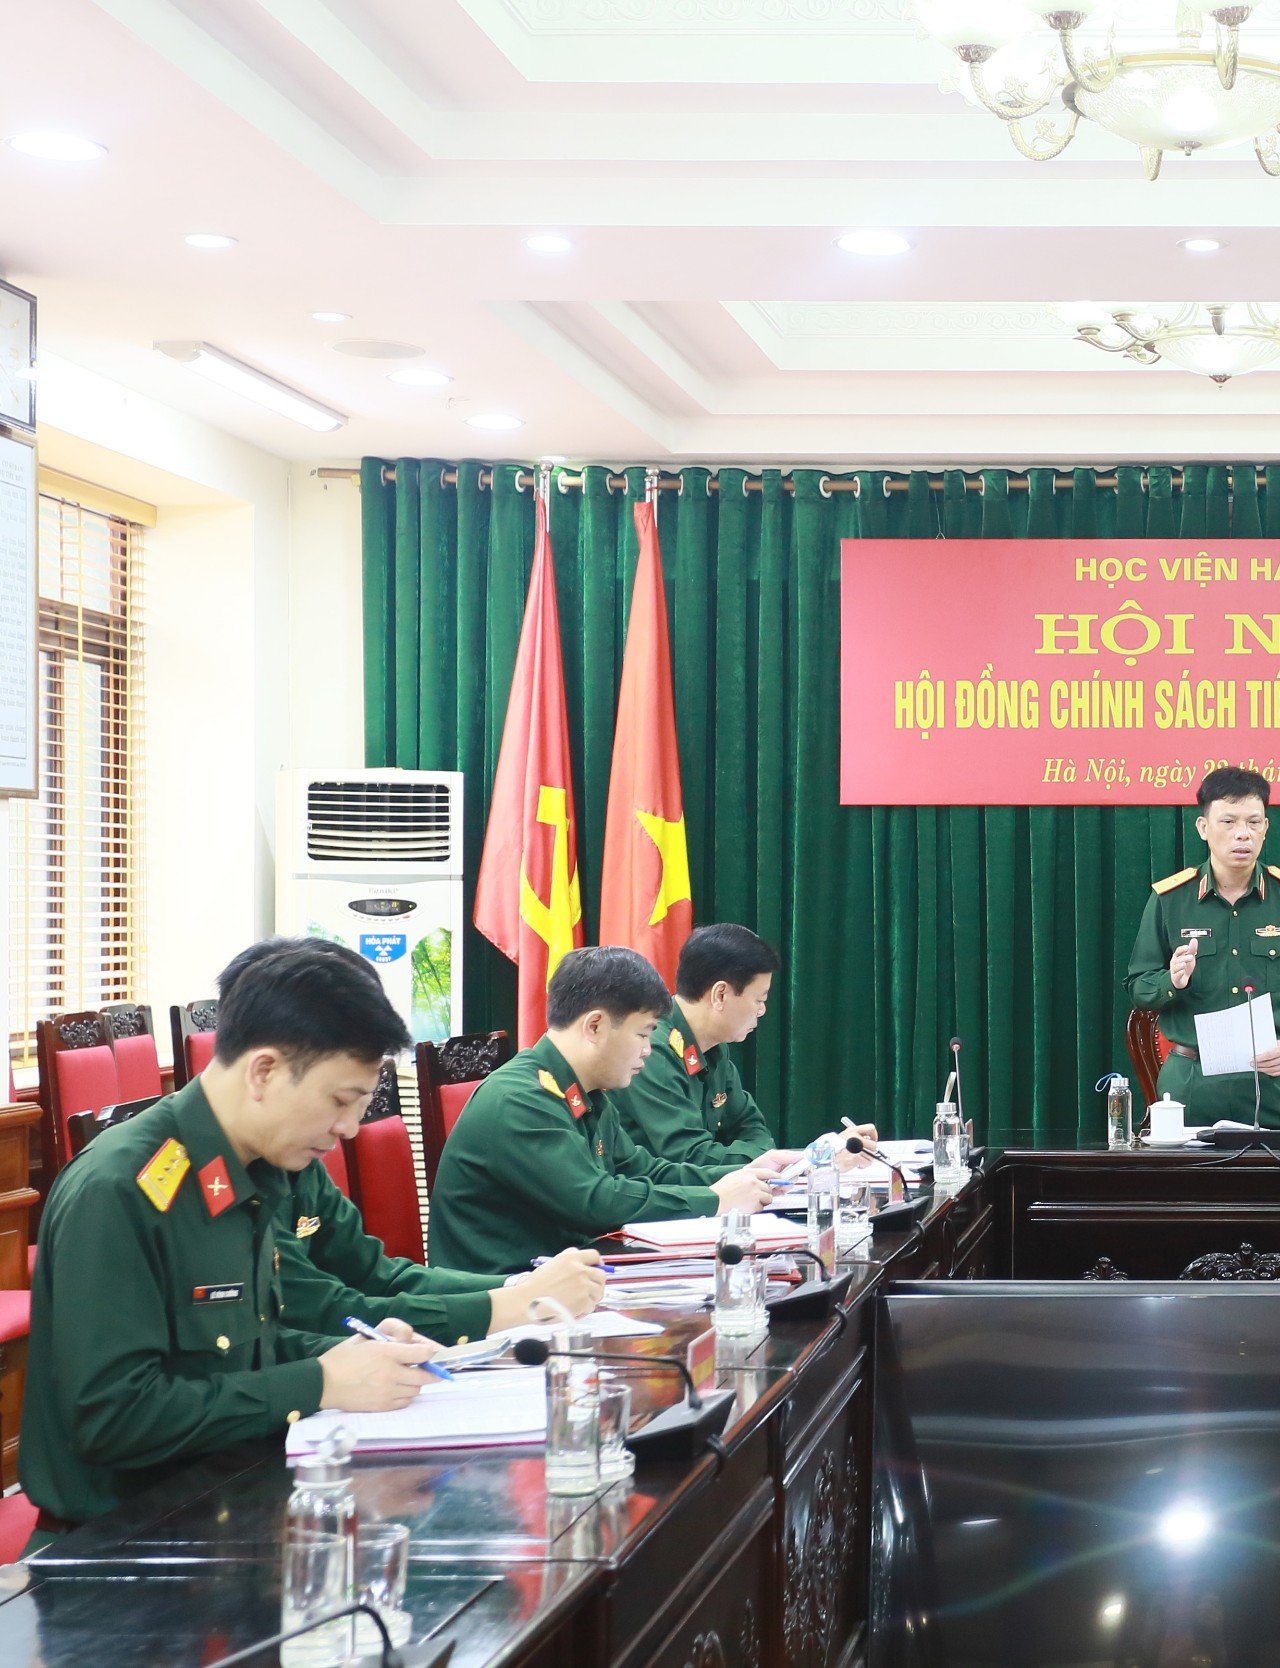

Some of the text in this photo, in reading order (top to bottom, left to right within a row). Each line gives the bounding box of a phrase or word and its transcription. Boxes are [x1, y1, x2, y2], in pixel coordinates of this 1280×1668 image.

[1076, 557, 1147, 589] HỌC
[1158, 552, 1238, 589] VIỆN
[1034, 599, 1195, 666] HỘI
[894, 669, 945, 740] HỘI
[955, 662, 1039, 730] ĐỒNG
[1050, 669, 1144, 730] CHÍNH
[1154, 669, 1236, 730] SÁCH
[1042, 758, 1077, 783] Hà
[1085, 758, 1131, 790] Nội,
[1140, 758, 1196, 789] ngày
